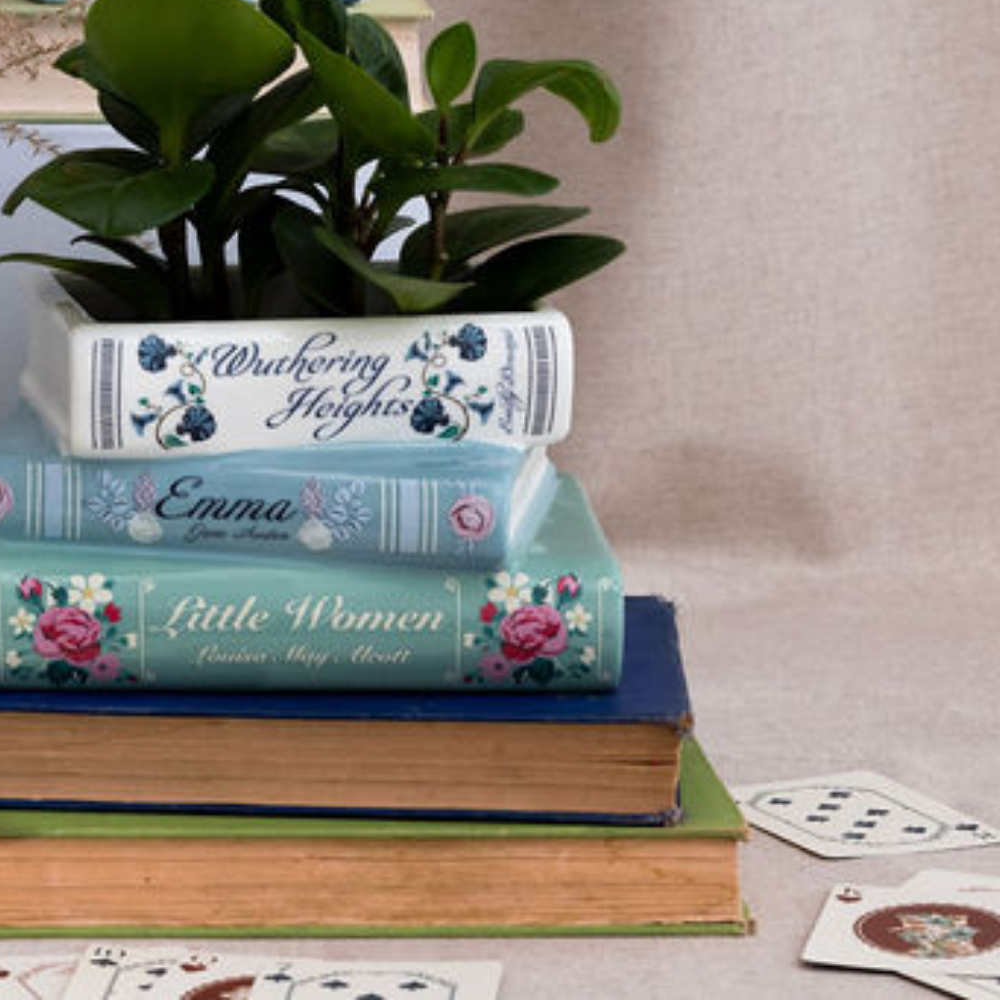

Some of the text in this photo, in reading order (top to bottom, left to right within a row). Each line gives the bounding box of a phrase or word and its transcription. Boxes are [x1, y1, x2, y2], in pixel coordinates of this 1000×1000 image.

[211, 331, 391, 396] Wuthering
[265, 375, 414, 441] Heights
[155, 475, 297, 522] Emma
[154, 595, 444, 638] Little Women
